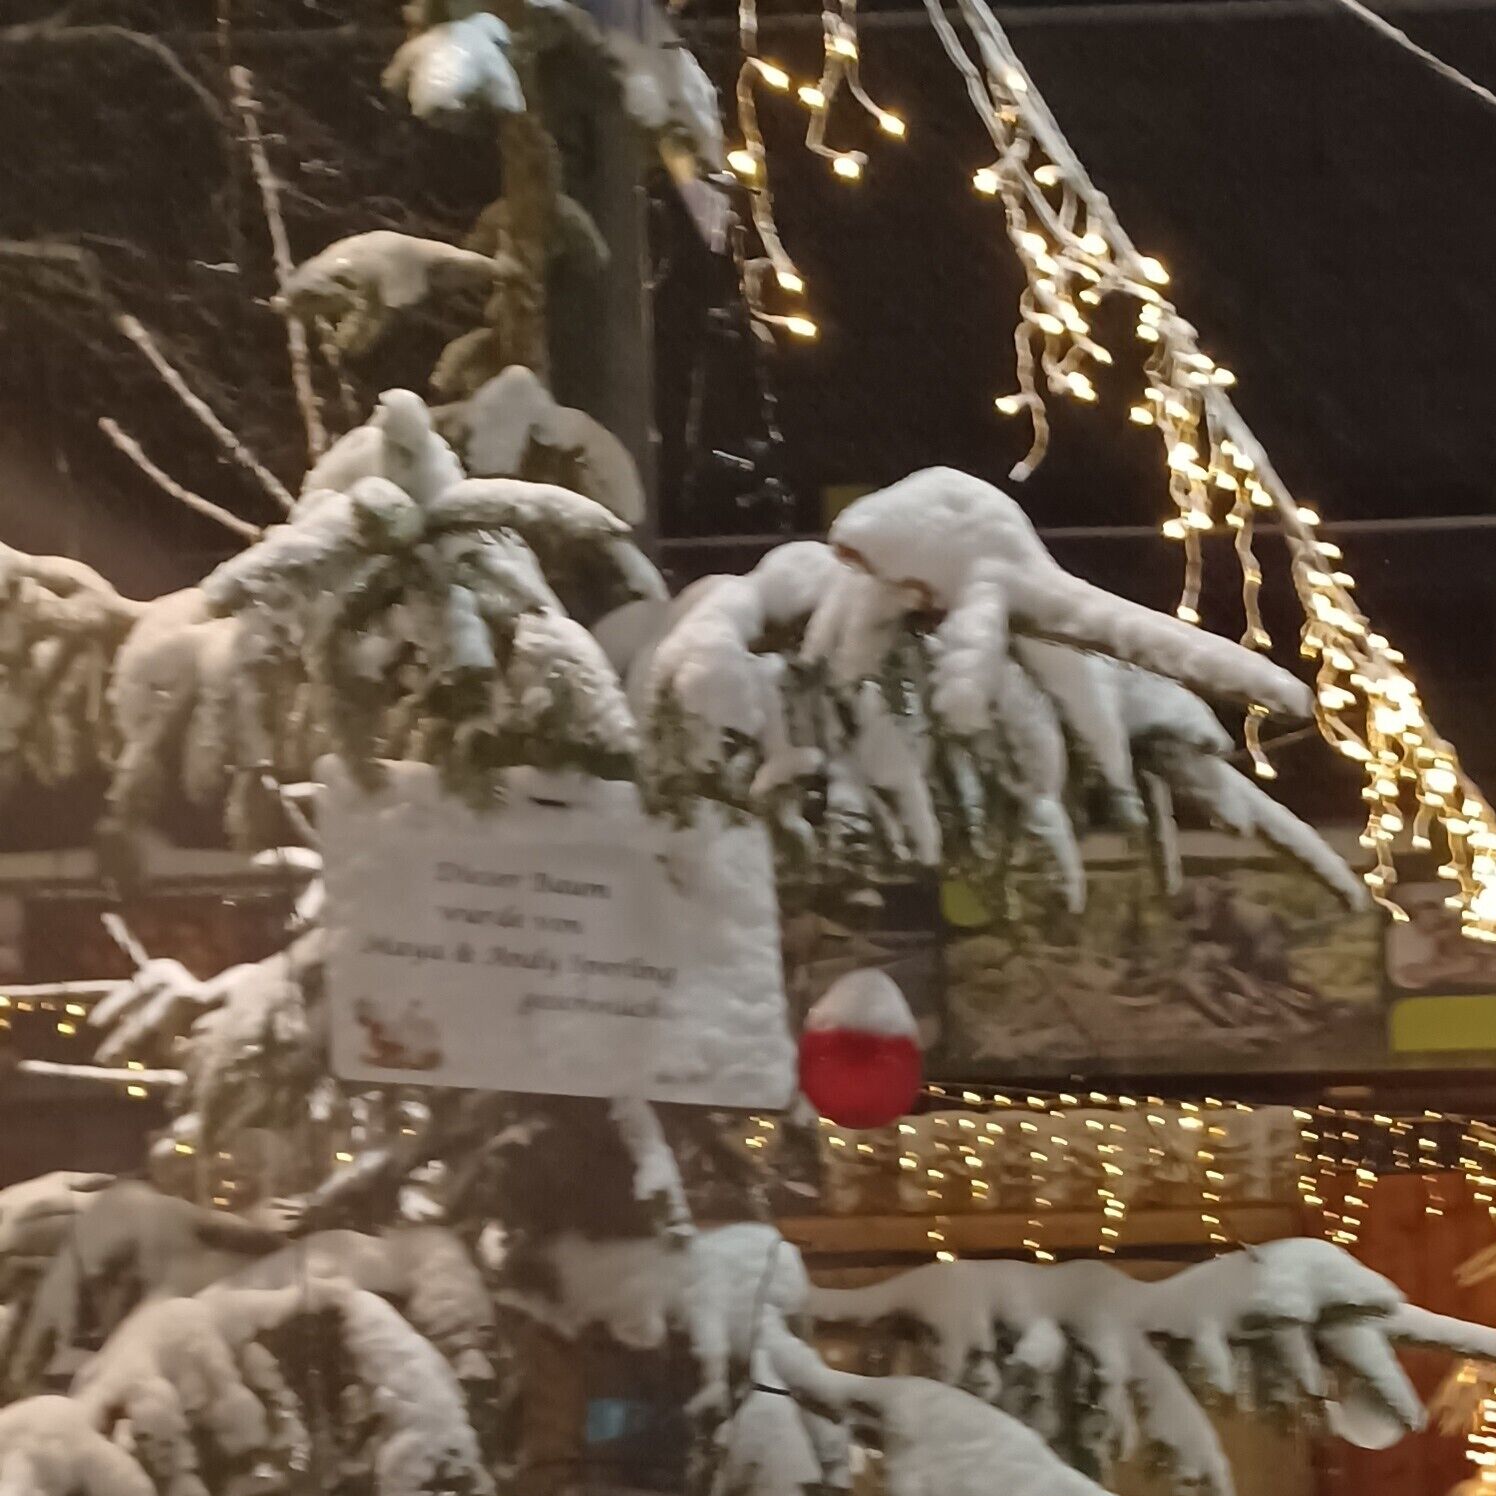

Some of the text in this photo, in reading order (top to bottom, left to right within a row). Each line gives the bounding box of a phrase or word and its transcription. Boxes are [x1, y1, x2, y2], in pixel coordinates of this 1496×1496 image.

[533, 870, 613, 898] Baum
[436, 904, 584, 935] wurde von
